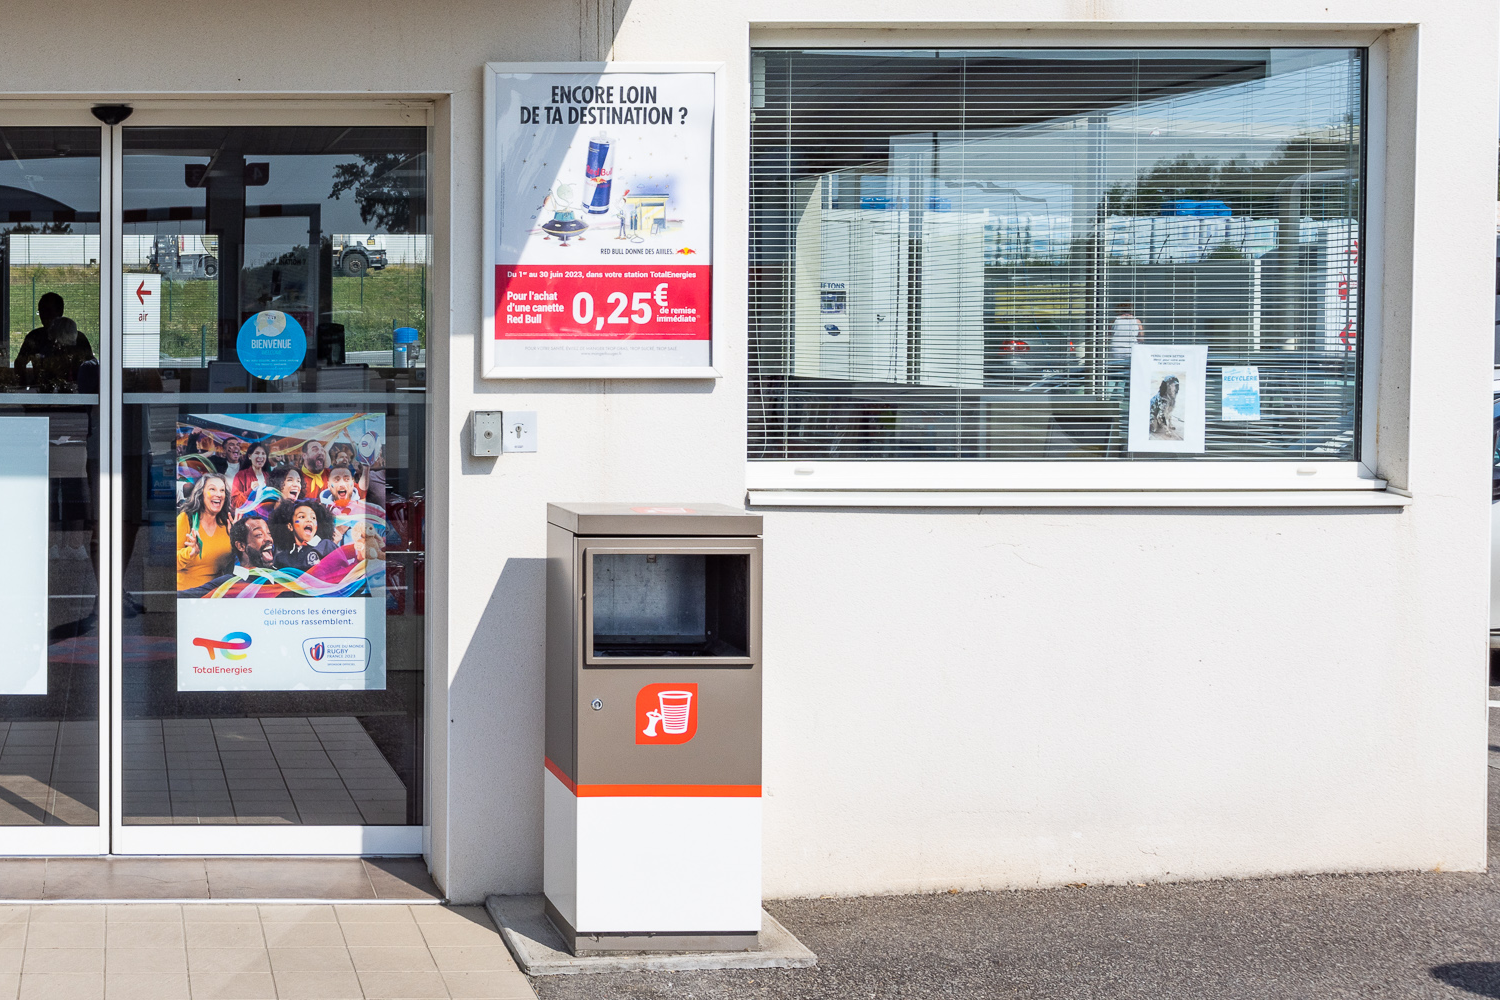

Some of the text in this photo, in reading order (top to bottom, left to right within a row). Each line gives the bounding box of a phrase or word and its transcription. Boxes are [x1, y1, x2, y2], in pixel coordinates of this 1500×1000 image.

[552, 86, 657, 104] ENCORE LOIN
[520, 107, 688, 125] DE TA DESTINATION ?
[550, 271, 563, 279] juin
[565, 271, 585, 279] 2023,
[650, 271, 697, 279] TotalEnergies
[507, 291, 558, 301] Pour l'achat
[507, 303, 564, 312] d'une canette
[138, 311, 149, 322] air
[507, 314, 542, 324] Red Bull
[656, 314, 697, 322] immédiate
[251, 339, 292, 349] BIENVENUE
[264, 608, 357, 617] Célébrons les énergies
[264, 618, 278, 627] qui
[301, 618, 354, 626] rassemblent.
[193, 666, 253, 675] TotalEnergies
